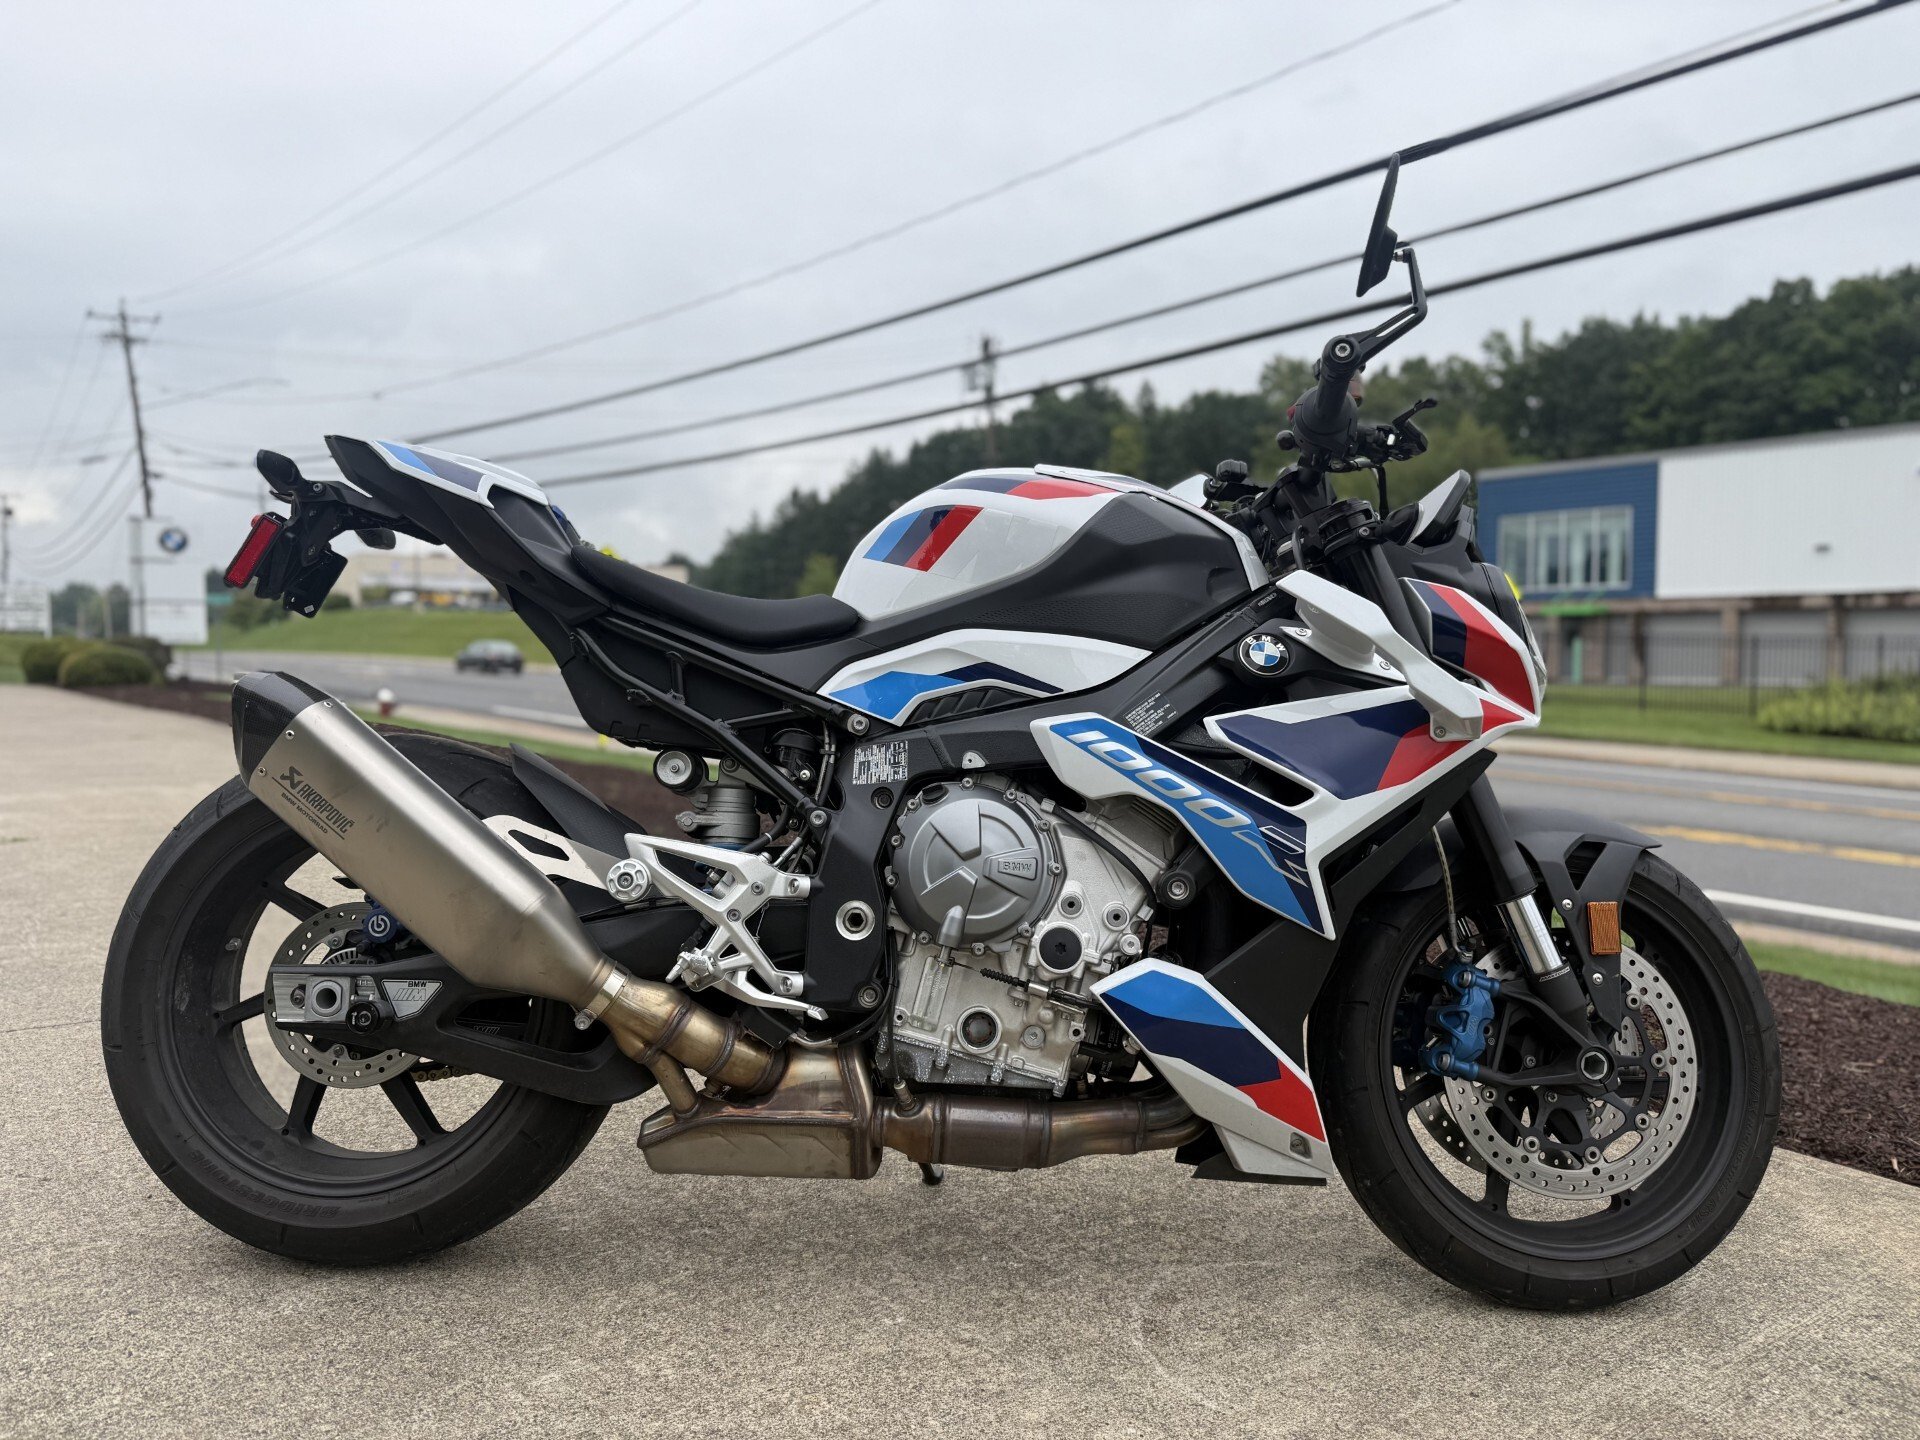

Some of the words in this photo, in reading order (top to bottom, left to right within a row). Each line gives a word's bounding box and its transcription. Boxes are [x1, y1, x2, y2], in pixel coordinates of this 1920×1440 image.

[1245, 635, 1286, 651] BMW
[1066, 730, 1251, 828] 1000
[281, 792, 297, 807] BMW
[296, 804, 328, 834] MOTORRAD
[297, 783, 355, 834] AKRAPOVIČ
[1002, 861, 1033, 872] BMW
[407, 980, 427, 988] BMW
